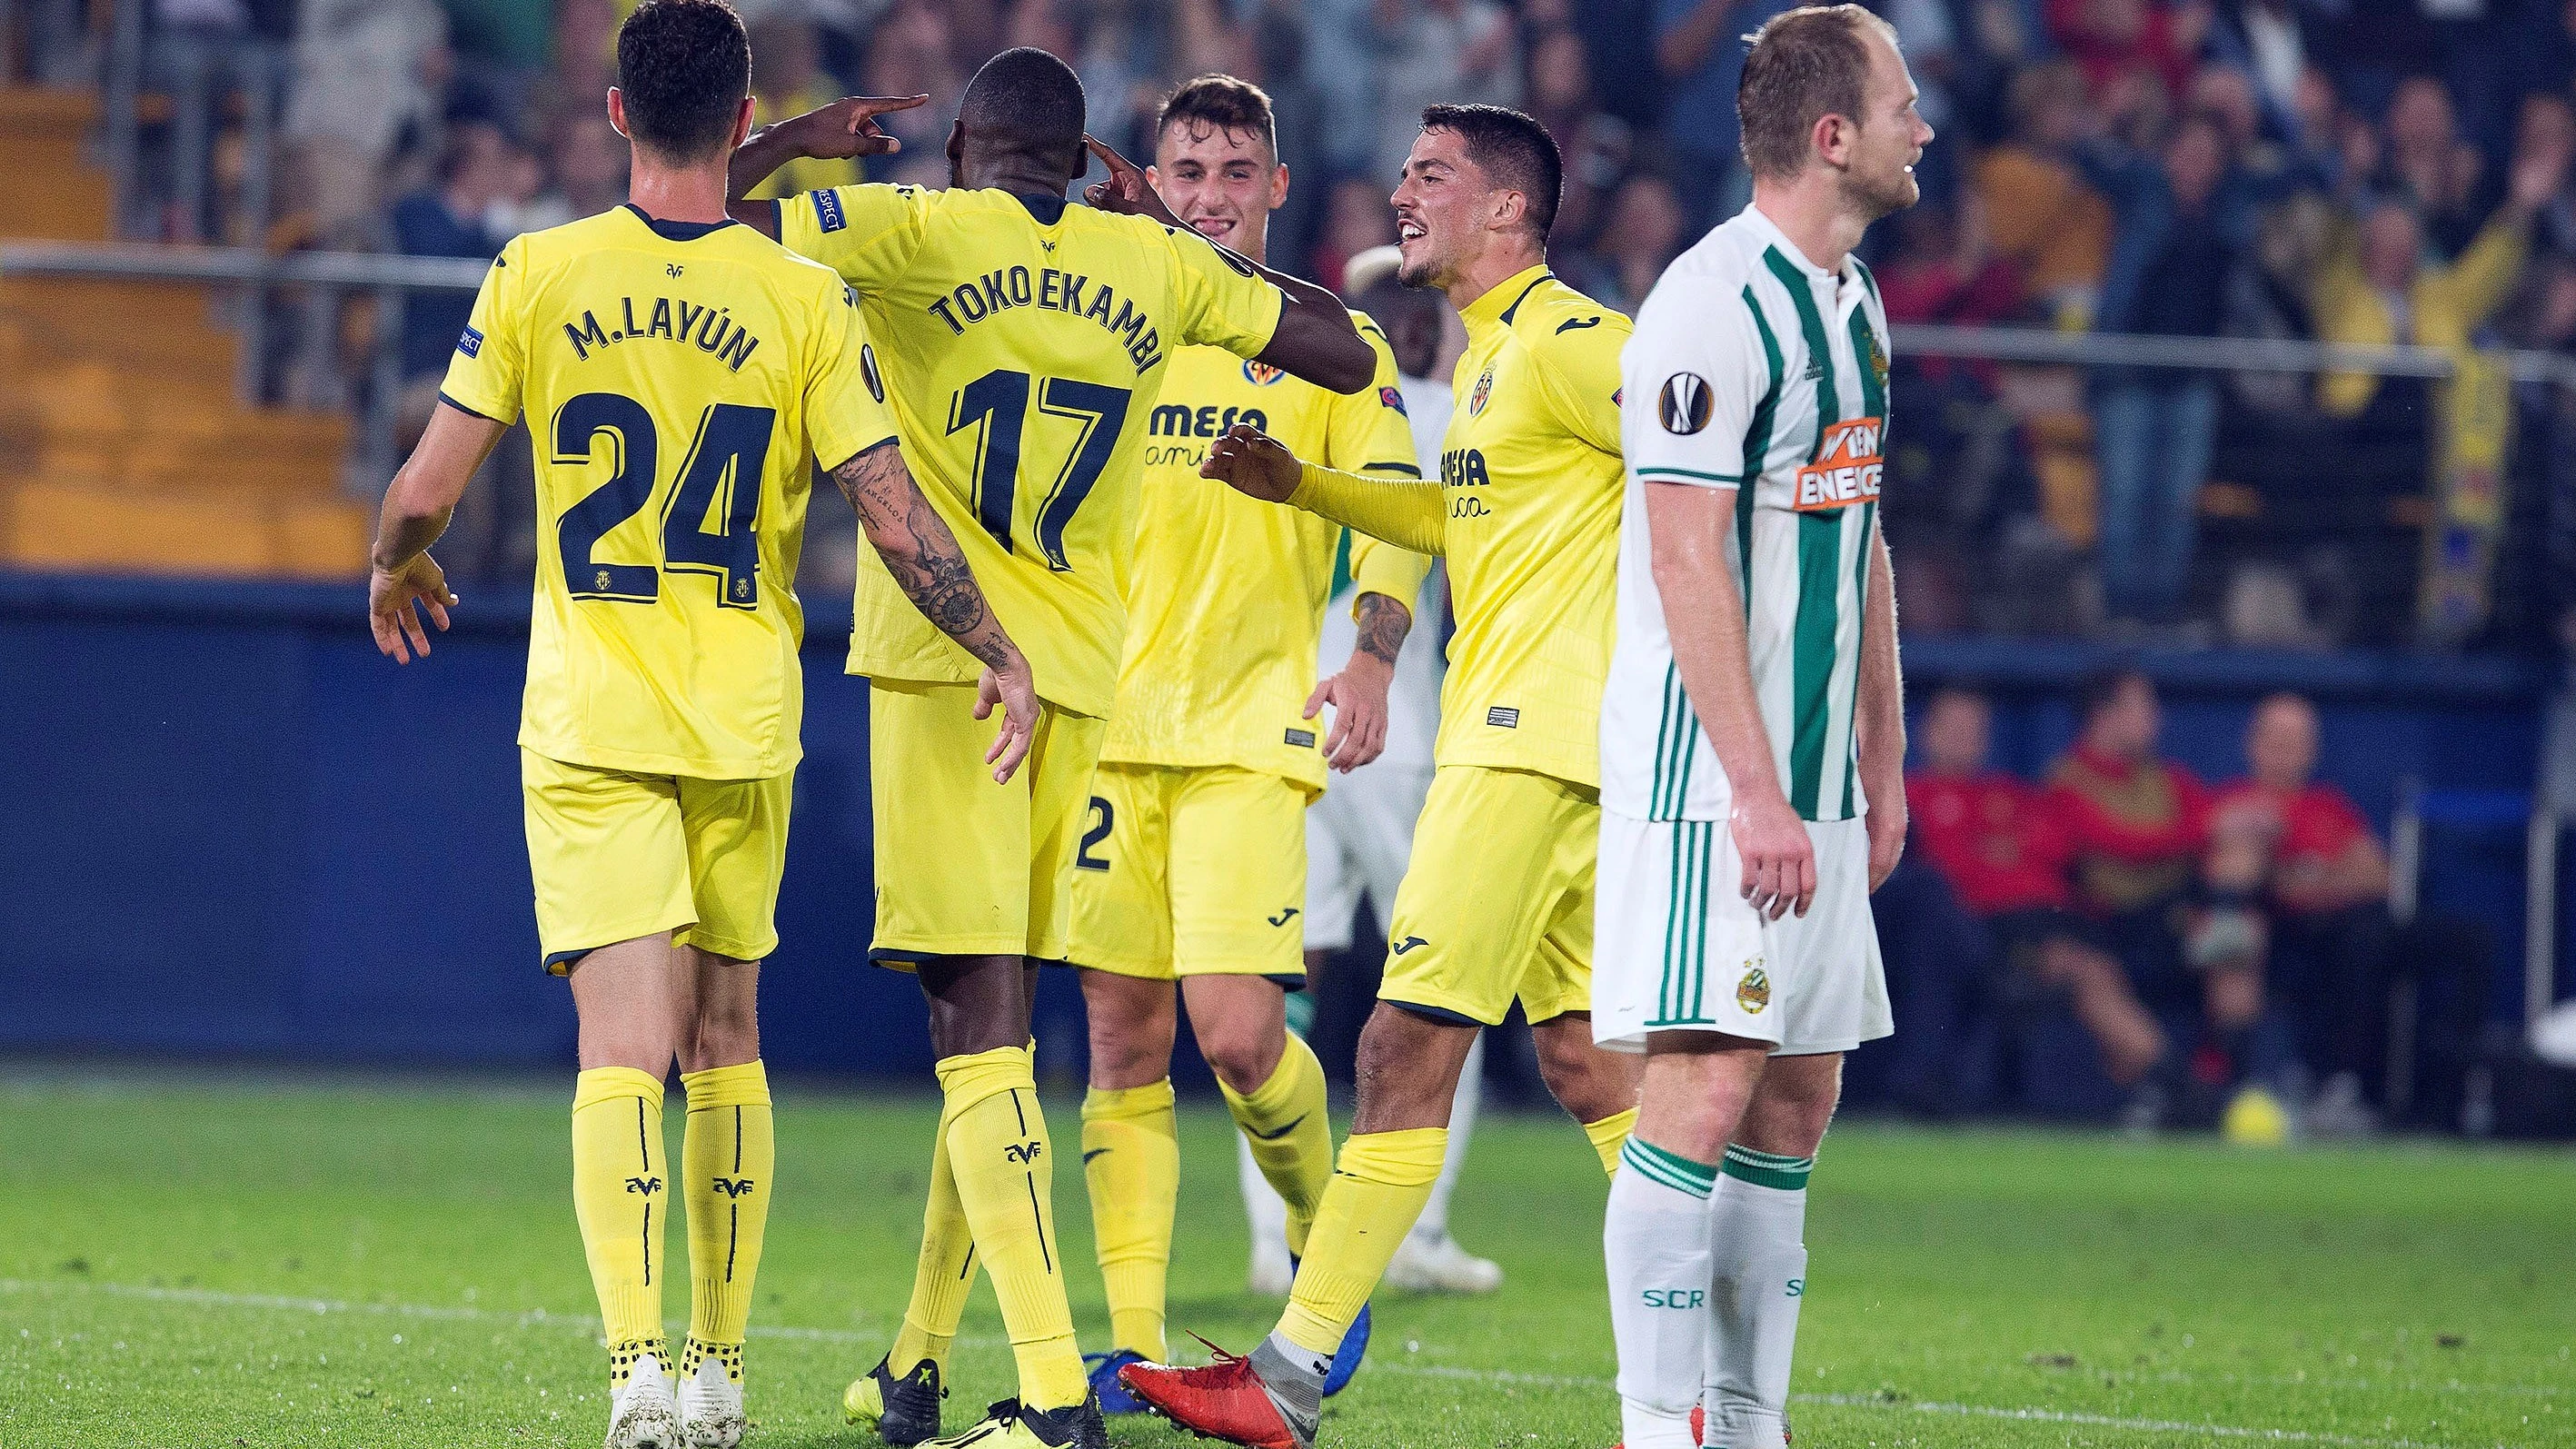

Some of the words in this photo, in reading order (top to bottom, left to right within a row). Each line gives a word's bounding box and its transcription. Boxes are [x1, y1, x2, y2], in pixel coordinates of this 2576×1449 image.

[818, 189, 840, 230] RESPECT
[562, 296, 760, 373] M.LAYÚN
[928, 265, 1031, 336] TOKO
[1038, 269, 1162, 377] EKAMBI
[1149, 404, 1268, 438] MESA
[550, 392, 777, 611] 24
[945, 369, 1133, 573] 17
[1642, 1289, 1706, 1310] SCR
